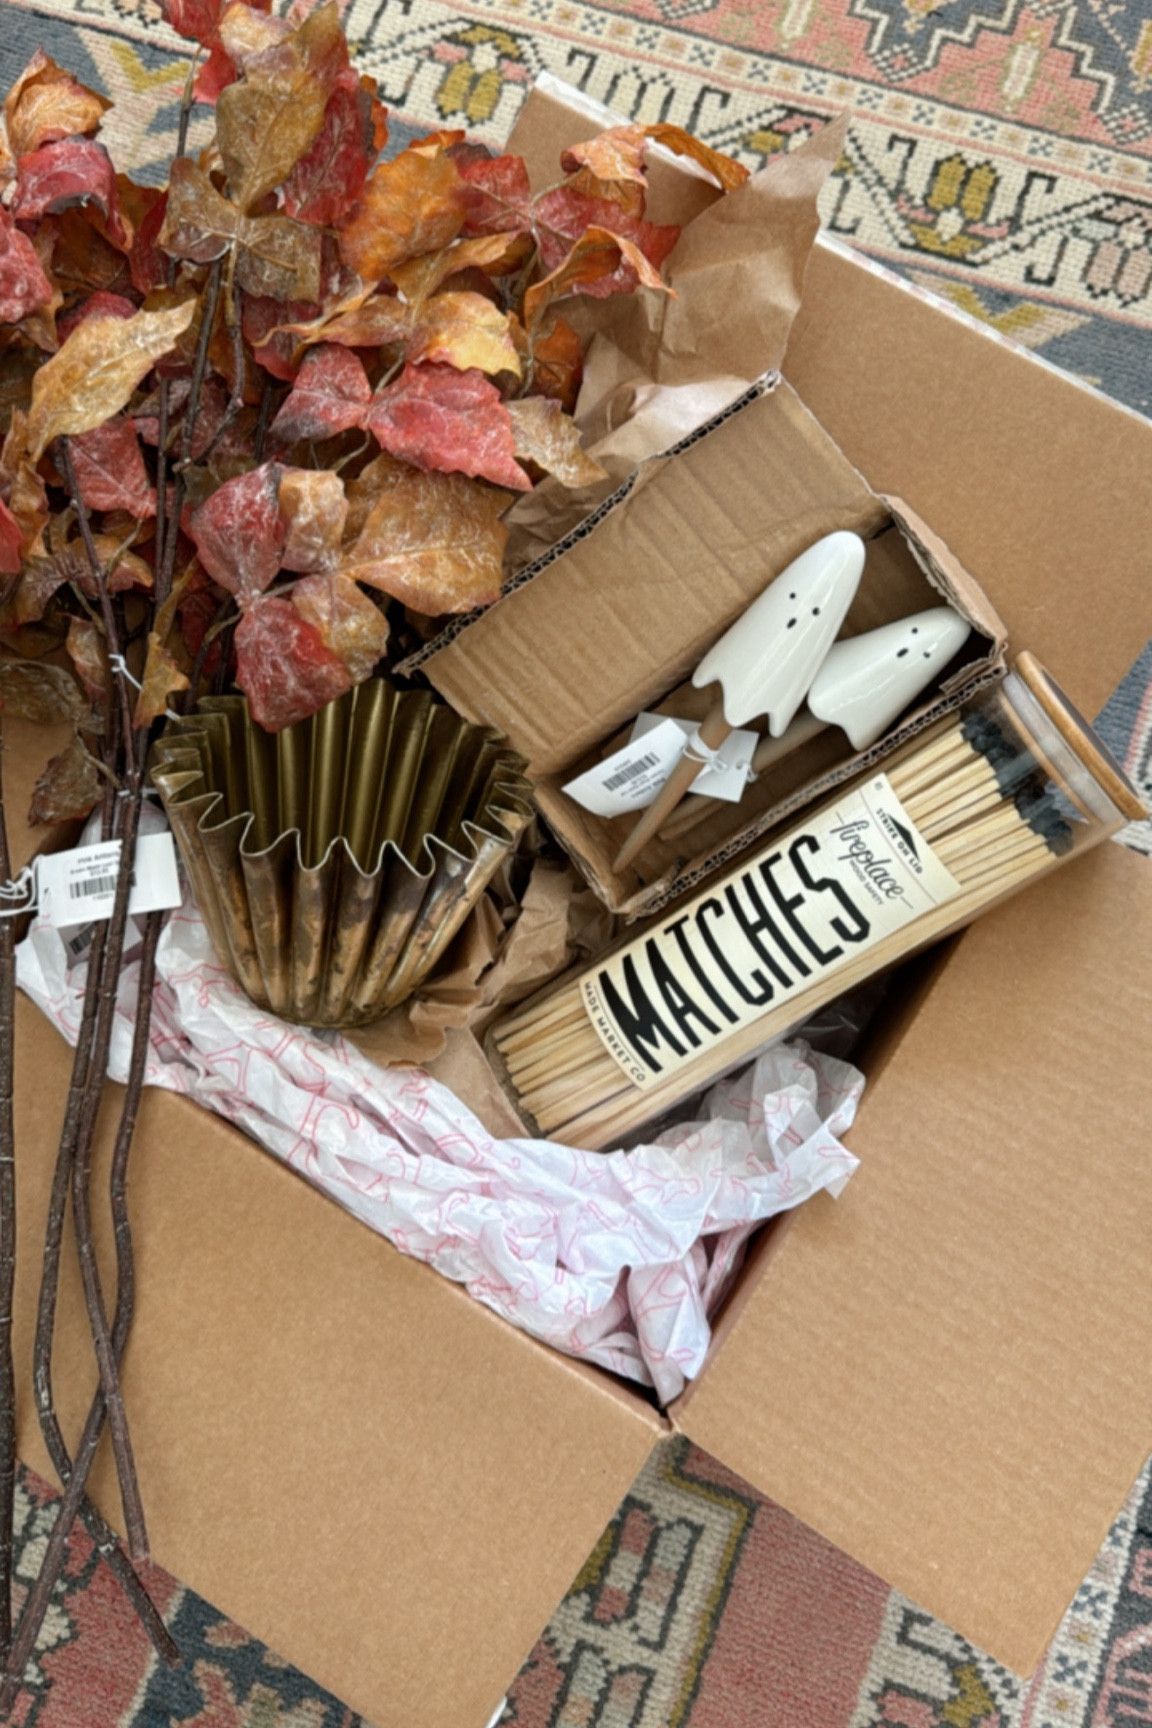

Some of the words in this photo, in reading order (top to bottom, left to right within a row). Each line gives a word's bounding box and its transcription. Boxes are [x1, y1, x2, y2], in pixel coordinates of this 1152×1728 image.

[829, 820, 904, 900] fireplace
[876, 808, 900, 840] STRIKE
[897, 841, 910, 857] ON
[908, 857, 923, 874] LID
[849, 858, 867, 882] WOOD
[864, 881, 884, 905] SAFETY
[598, 834, 871, 1074] MATCHES
[584, 981, 599, 1014] MADE
[597, 1017, 632, 1064] MARKET
[630, 1066, 646, 1082] CO
